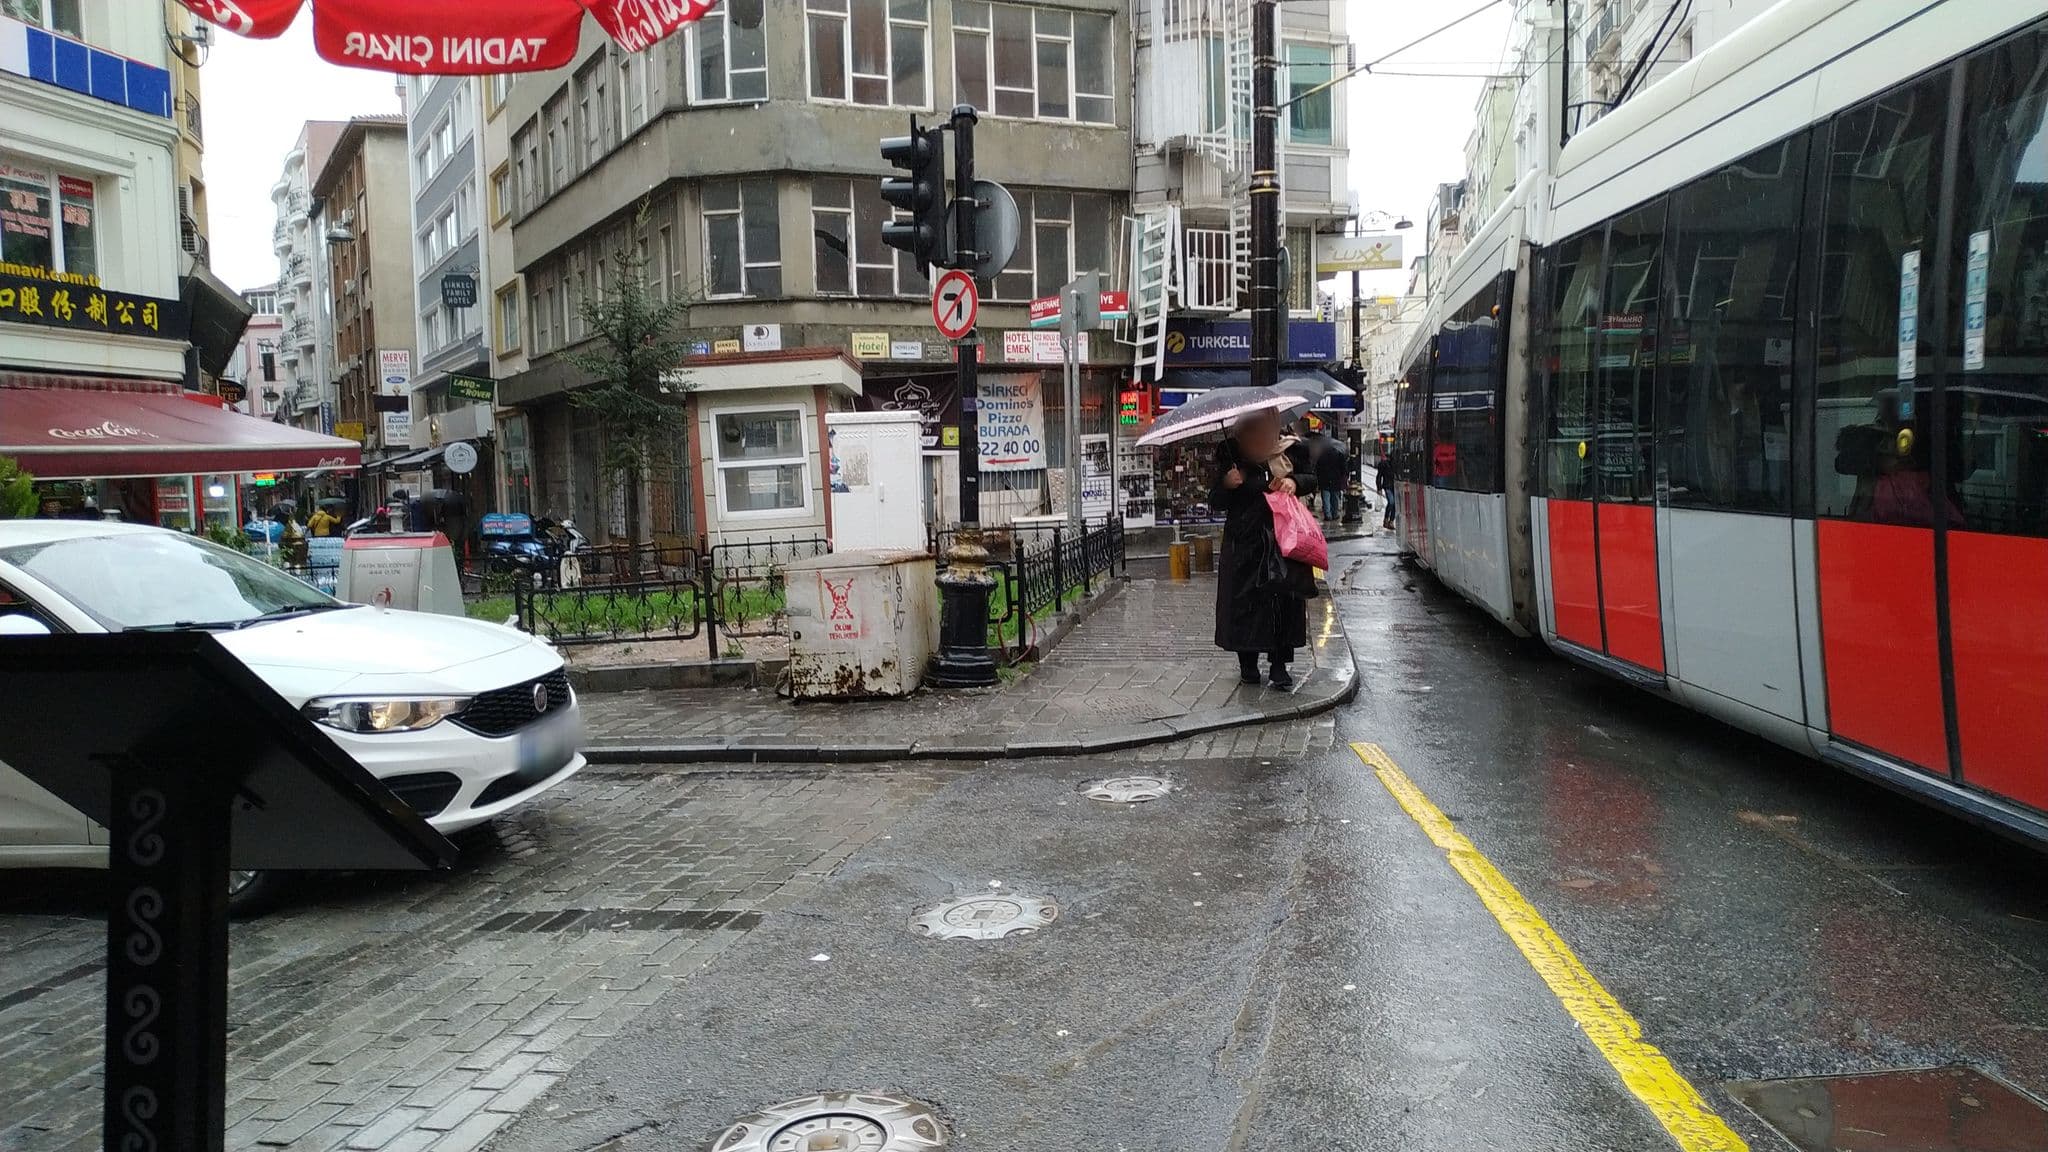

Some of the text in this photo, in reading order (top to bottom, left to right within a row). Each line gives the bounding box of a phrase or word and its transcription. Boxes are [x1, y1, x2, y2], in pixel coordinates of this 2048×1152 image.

[1100, 294, 1114, 304] İYE
[1005, 333, 1031, 343] HOTEL
[1190, 335, 1250, 349] TURKCELL
[858, 341, 884, 351] Hotel
[1006, 344, 1031, 354] EMEK
[383, 353, 408, 362] MERVE
[988, 412, 1022, 424] Pizza
[980, 424, 1031, 437] BURADA
[1003, 440, 1019, 455] 40
[1023, 439, 1040, 454] 00
